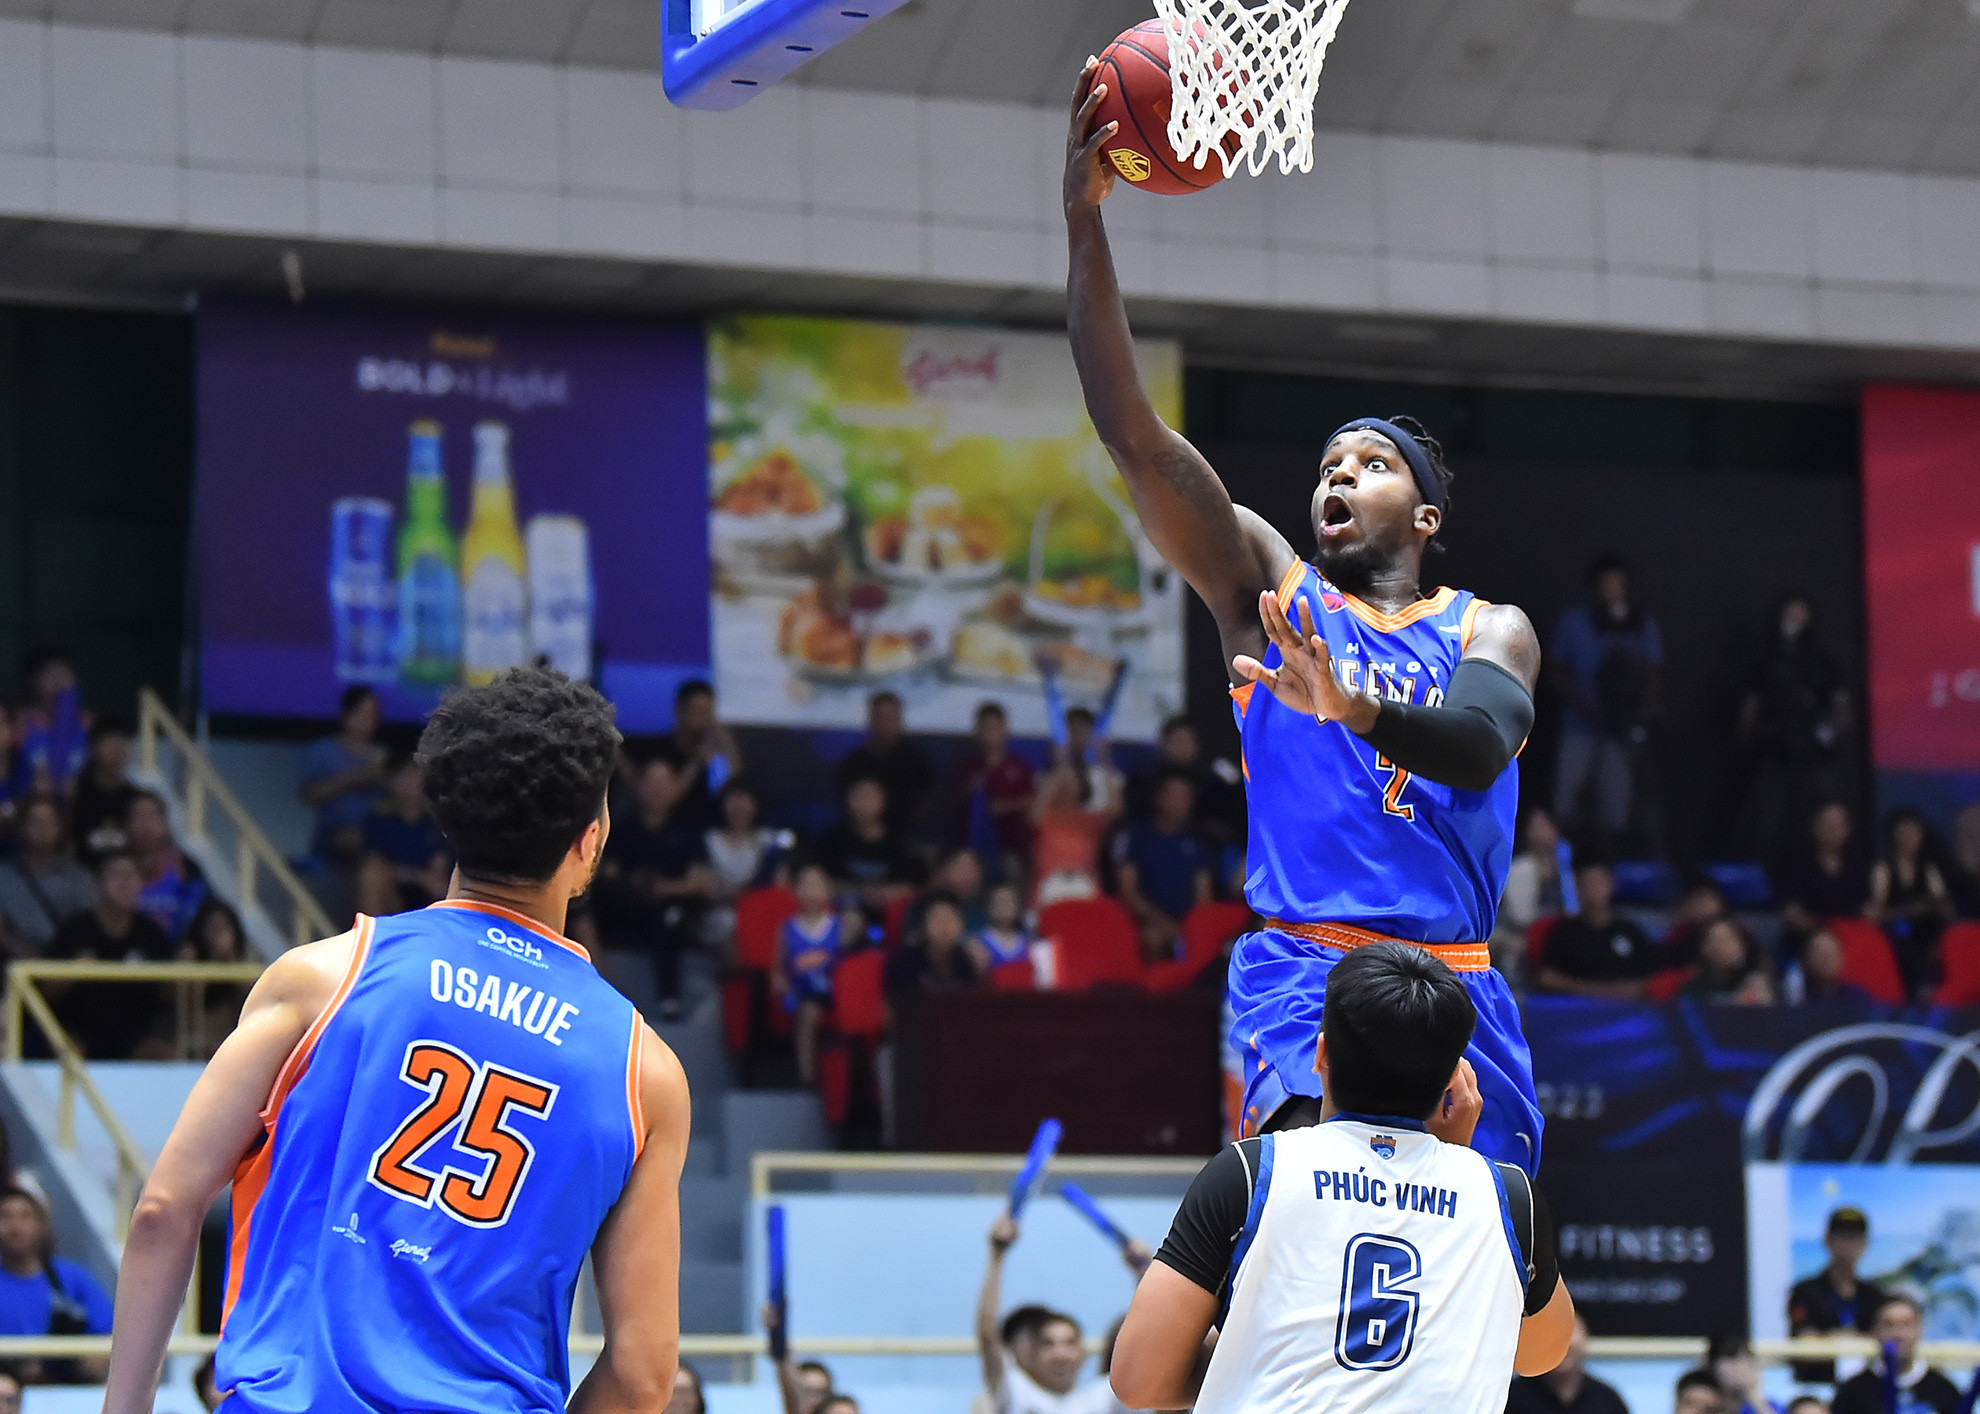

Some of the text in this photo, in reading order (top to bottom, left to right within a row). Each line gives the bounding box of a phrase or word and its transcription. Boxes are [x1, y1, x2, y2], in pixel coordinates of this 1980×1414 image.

[1375, 750, 1415, 823] 2
[486, 927, 543, 961] OCH
[430, 958, 580, 1047] OSAKUE
[1536, 1081, 1606, 1120] 023
[366, 1038, 561, 1230] 25
[1313, 1166, 1458, 1219] PHÚC VINH
[1560, 1224, 1714, 1263] FITNESS
[1334, 1232, 1422, 1372] 6
